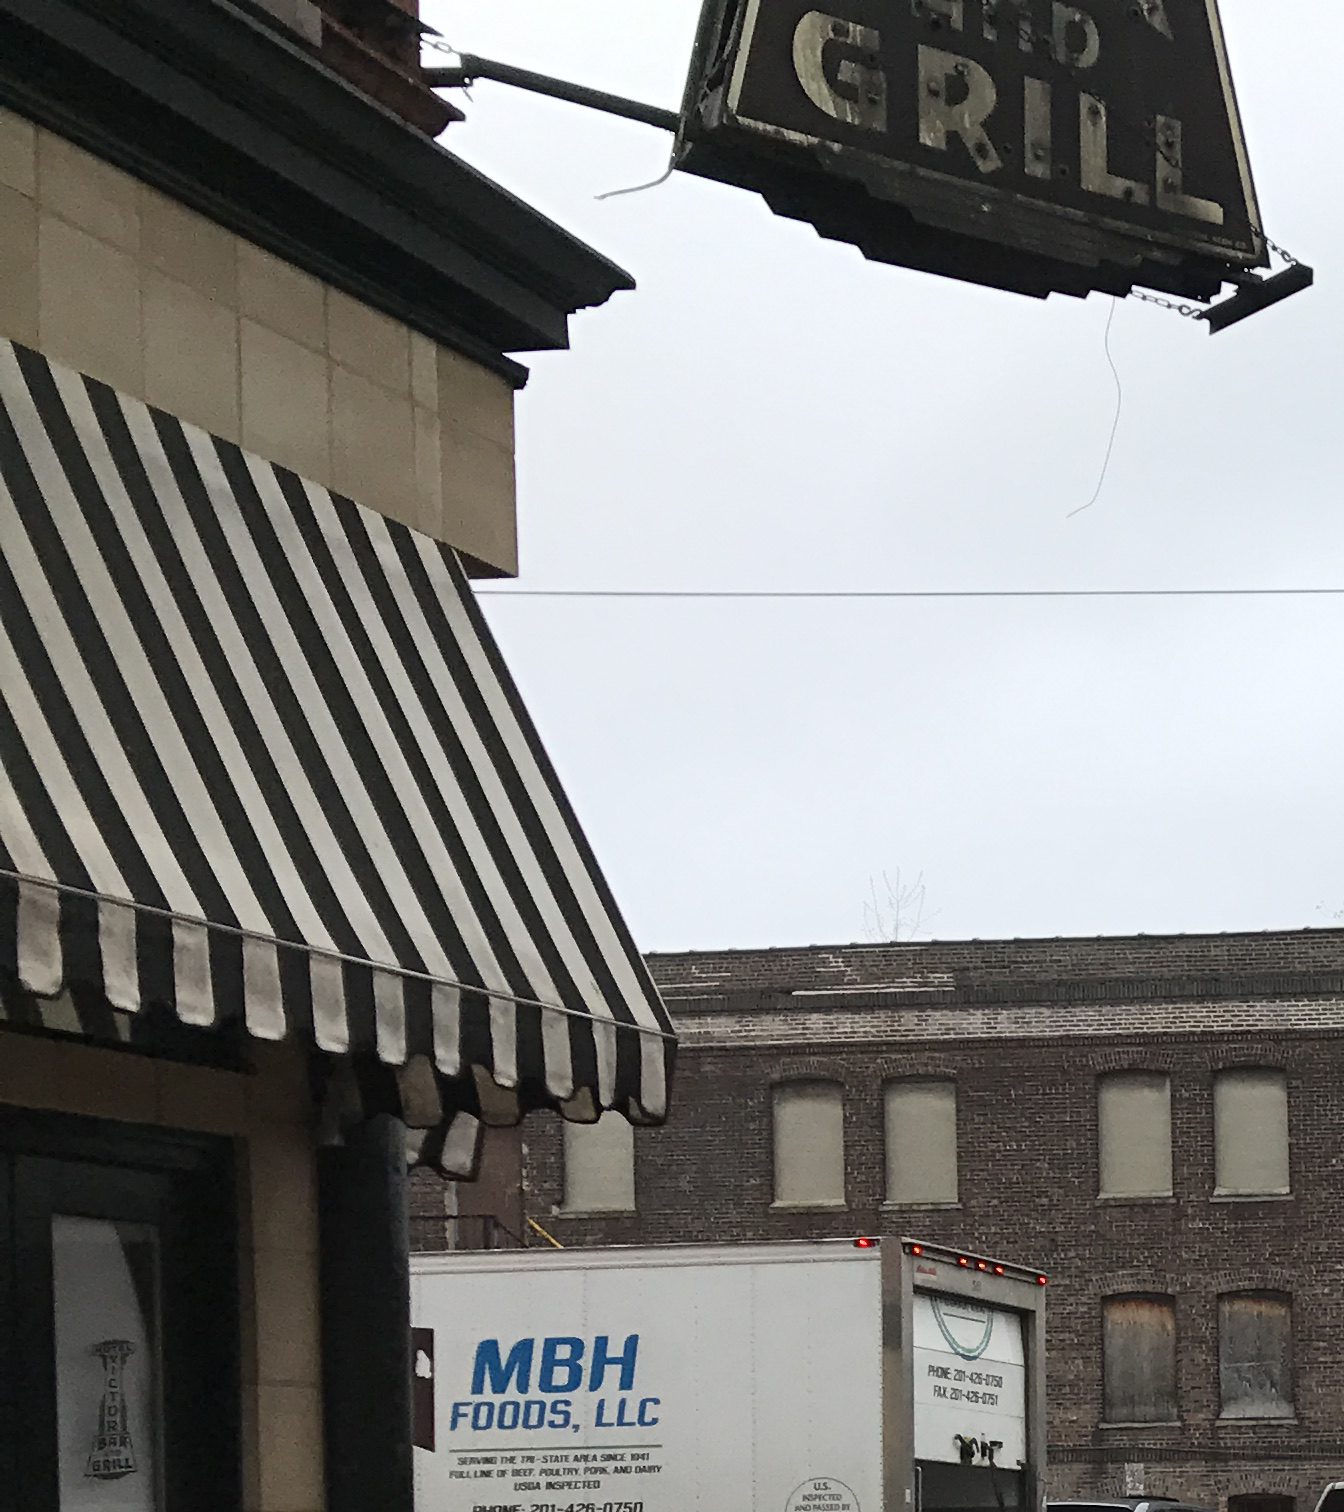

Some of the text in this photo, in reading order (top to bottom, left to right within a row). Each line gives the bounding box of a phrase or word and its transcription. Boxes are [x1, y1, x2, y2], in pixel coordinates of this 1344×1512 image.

[793, 10, 1223, 225] GRILL
[470, 1334, 639, 1395] MBH
[450, 1397, 661, 1433] FOODS, LLC
[545, 1479, 601, 1490] INSPECTED
